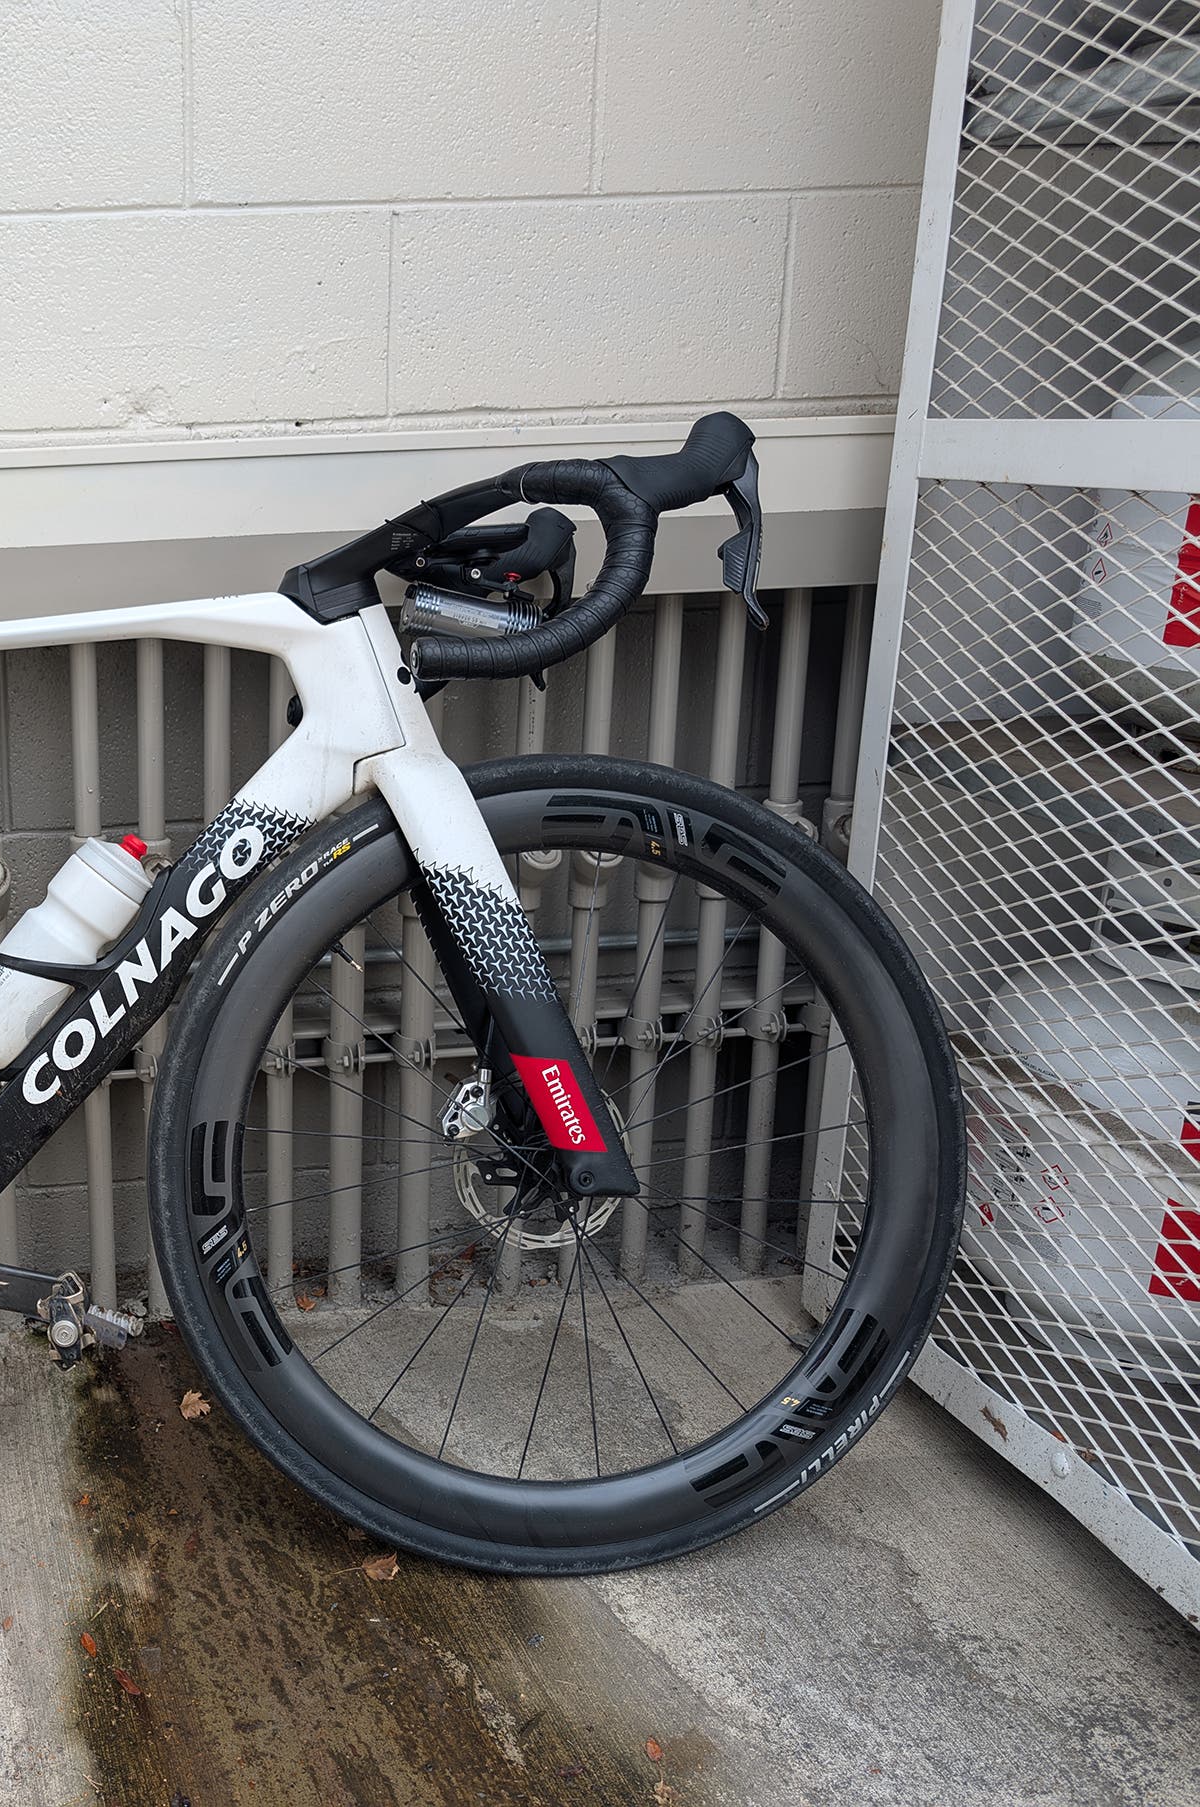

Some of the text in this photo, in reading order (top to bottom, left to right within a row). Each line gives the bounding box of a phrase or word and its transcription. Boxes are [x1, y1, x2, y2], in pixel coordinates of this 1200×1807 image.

[323, 837, 349, 859] RACE
[332, 842, 351, 860] RS
[651, 840, 661, 857] 4.5
[237, 860, 319, 956] P ZERO
[22, 825, 264, 1104] COLNAGO
[541, 1065, 586, 1145] Emirates
[237, 1240, 248, 1260] 4.5
[780, 1396, 801, 1408] 4.5
[799, 1394, 881, 1484] PIRELLI
